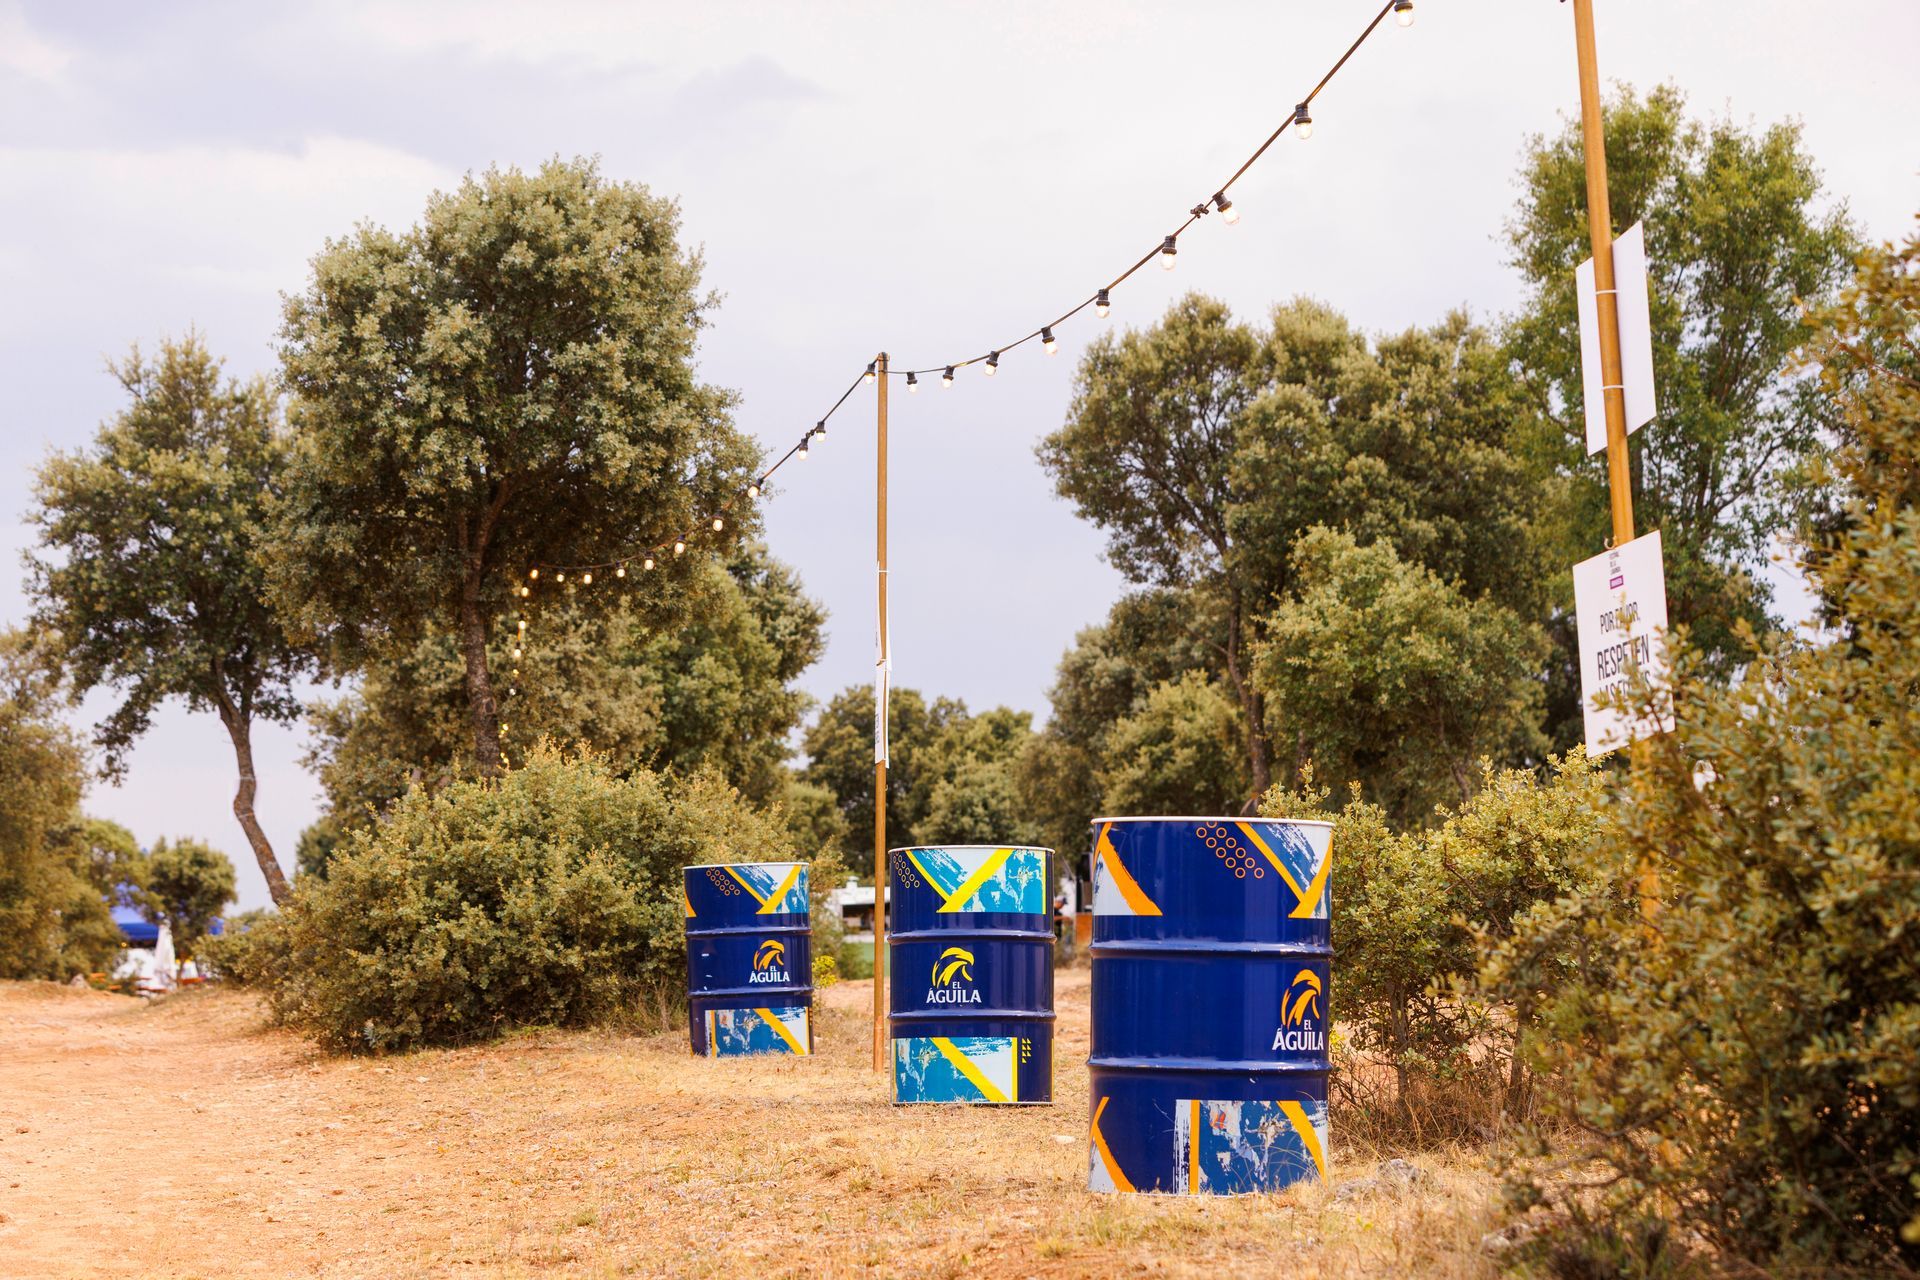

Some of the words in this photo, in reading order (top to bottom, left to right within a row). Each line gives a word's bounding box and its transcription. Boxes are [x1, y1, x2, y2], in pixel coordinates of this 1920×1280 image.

[1600, 611, 1615, 635] POR
[749, 971, 790, 983] ÁGUILA
[952, 981, 962, 989] EL
[926, 988, 982, 1003] ÁGUILA
[1304, 1019, 1312, 1030] EL
[1272, 1028, 1324, 1050] ÁGUILA
